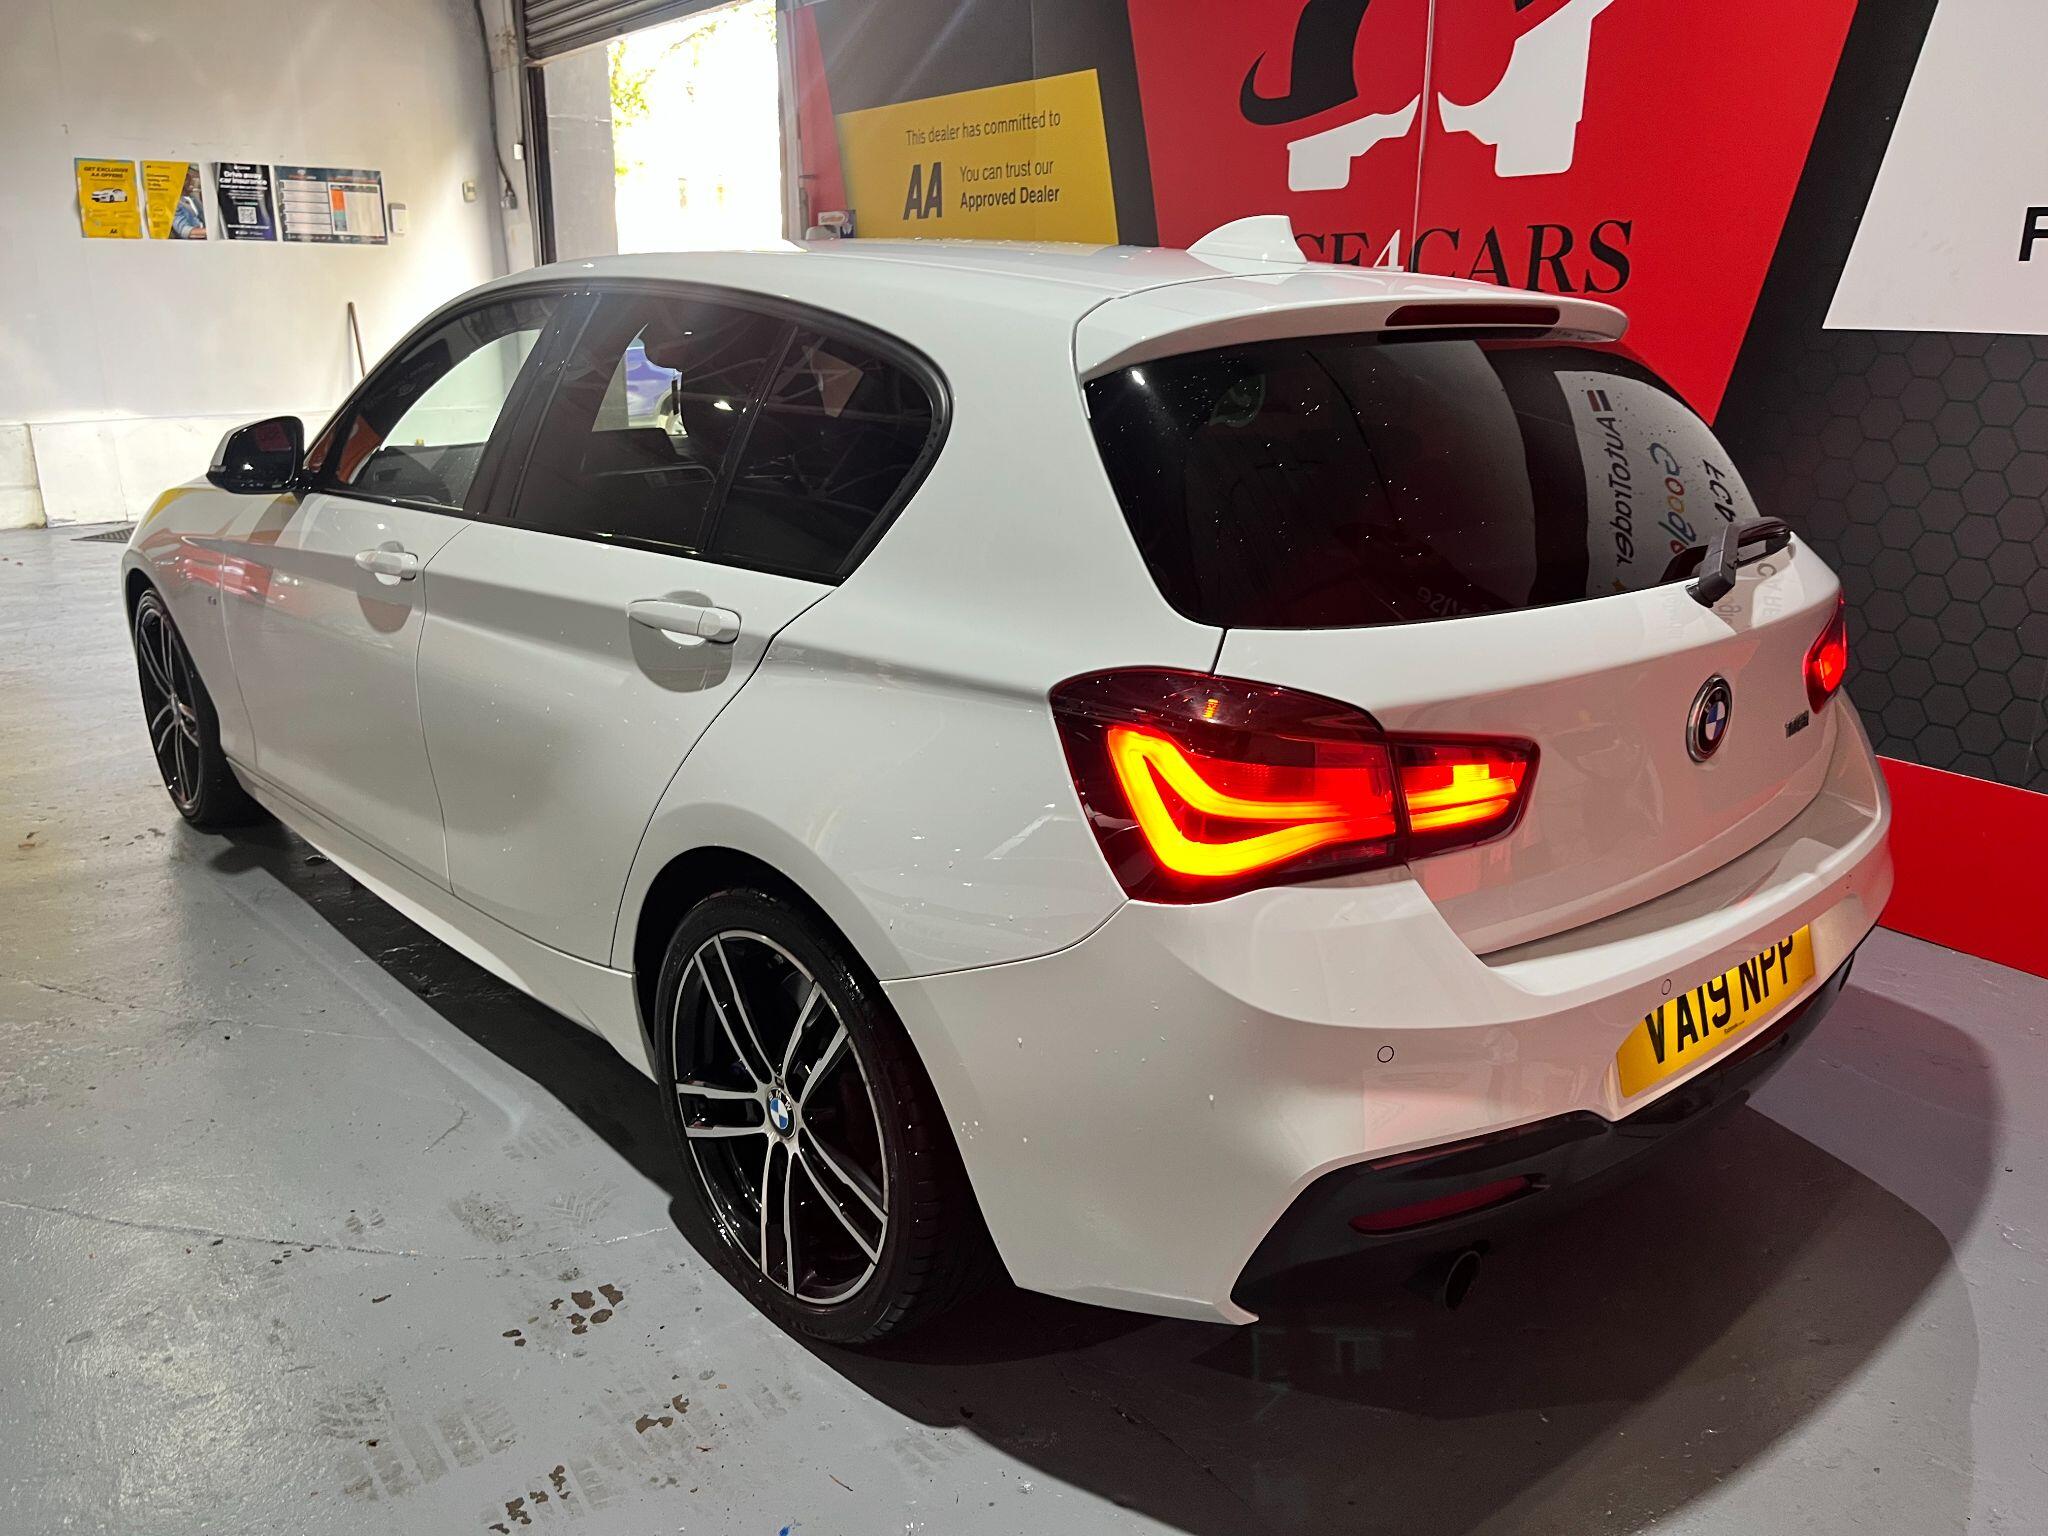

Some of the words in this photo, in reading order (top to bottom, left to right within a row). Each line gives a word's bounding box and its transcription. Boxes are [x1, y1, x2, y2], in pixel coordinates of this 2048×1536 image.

[905, 129, 926, 146] This
[928, 124, 960, 143] dealer
[962, 122, 981, 138] has
[983, 110, 1046, 135] committed
[1049, 111, 1061, 127] to
[223, 170, 243, 178] Drive
[232, 177, 268, 185] insurance
[959, 165, 980, 182] You
[982, 164, 1002, 180] can
[1005, 159, 1031, 178] trust
[1034, 160, 1054, 176] our
[902, 161, 943, 221] AA
[960, 186, 1016, 212] Approved
[1020, 185, 1060, 204] Dealer
[1644, 973, 1731, 1064] VA19
[1738, 934, 1793, 1012] NPP
